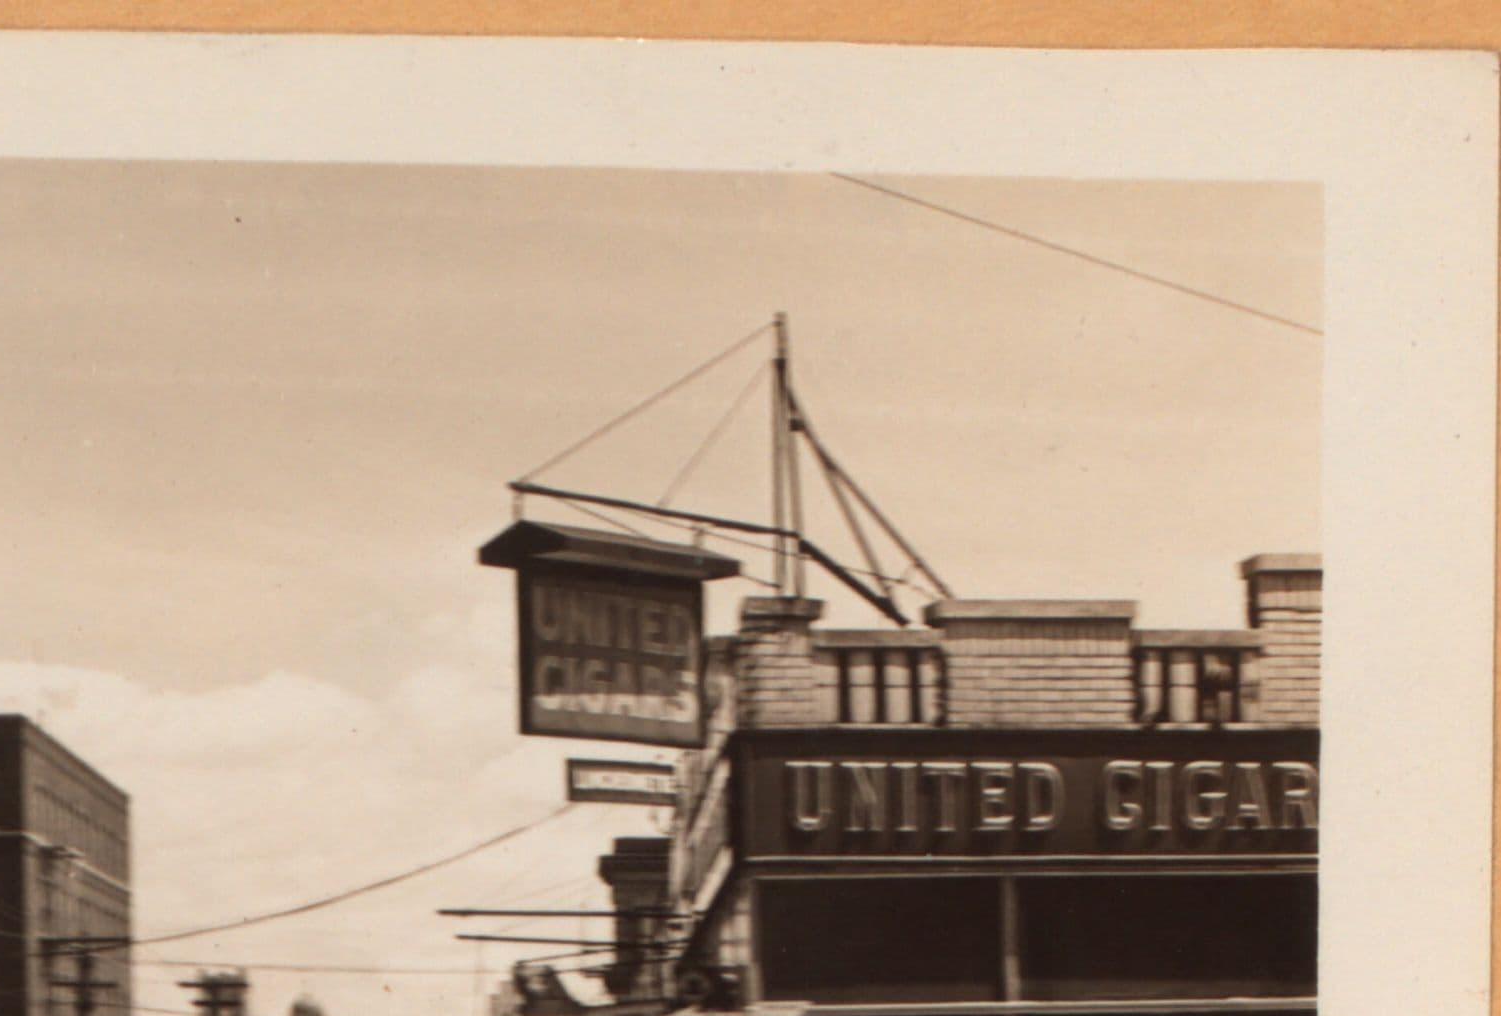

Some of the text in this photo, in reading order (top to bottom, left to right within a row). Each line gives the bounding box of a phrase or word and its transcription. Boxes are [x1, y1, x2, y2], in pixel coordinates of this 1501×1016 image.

[532, 583, 696, 657] UNITED
[532, 654, 698, 723] CIGARS
[785, 760, 1066, 831] UNITED
